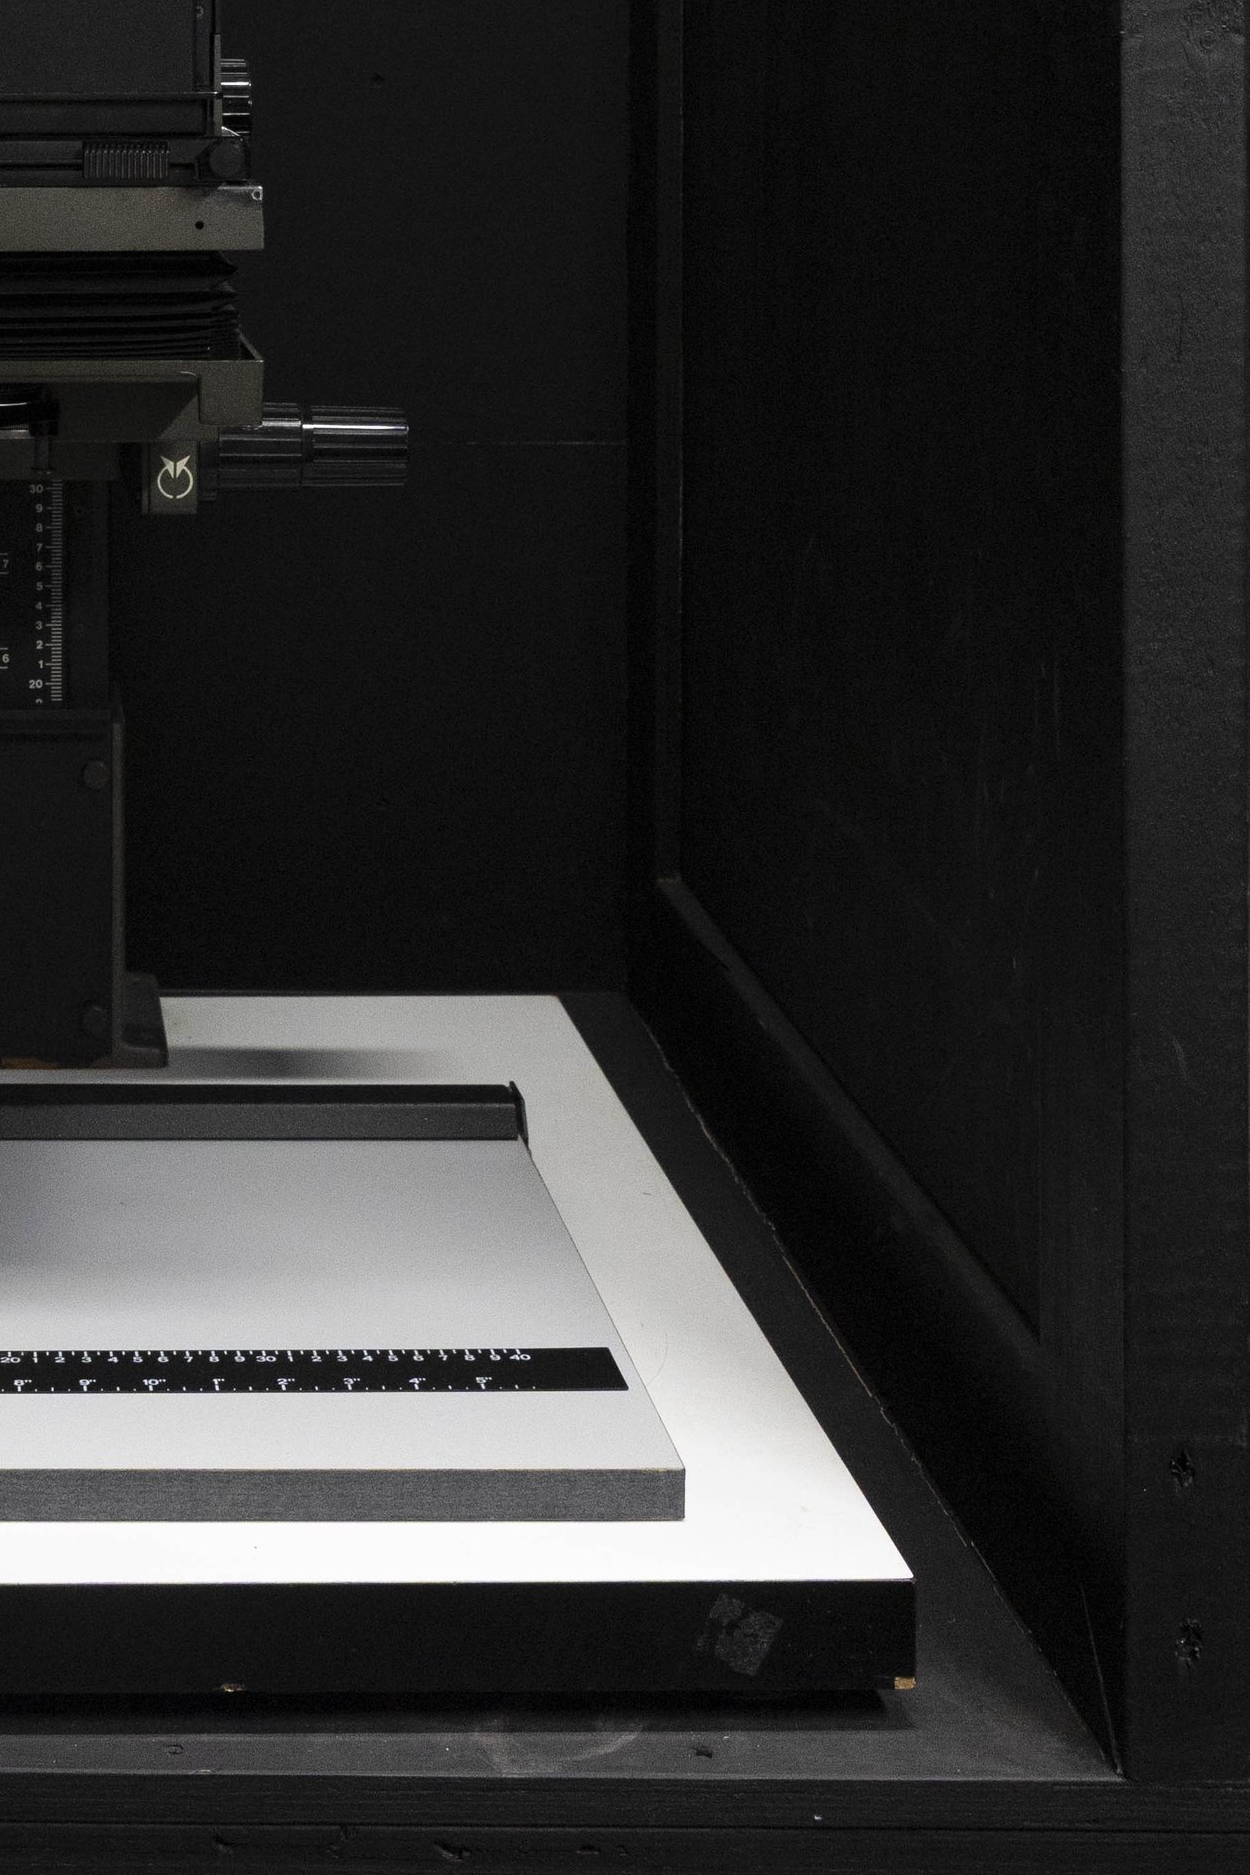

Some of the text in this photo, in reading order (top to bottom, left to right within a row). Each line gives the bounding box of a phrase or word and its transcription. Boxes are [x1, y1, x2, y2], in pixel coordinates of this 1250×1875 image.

[30, 484, 43, 493] 30
[36, 504, 43, 512] 9
[36, 523, 43, 532] 8
[37, 543, 43, 551] 7
[3, 559, 9, 568] 7
[36, 562, 42, 571] 6
[37, 582, 43, 590] 5
[36, 602, 42, 610] 4
[36, 621, 42, 630] 3
[37, 641, 42, 649] 2
[3, 654, 9, 663] 6
[39, 660, 43, 668] 1
[29, 679, 42, 688] 20
